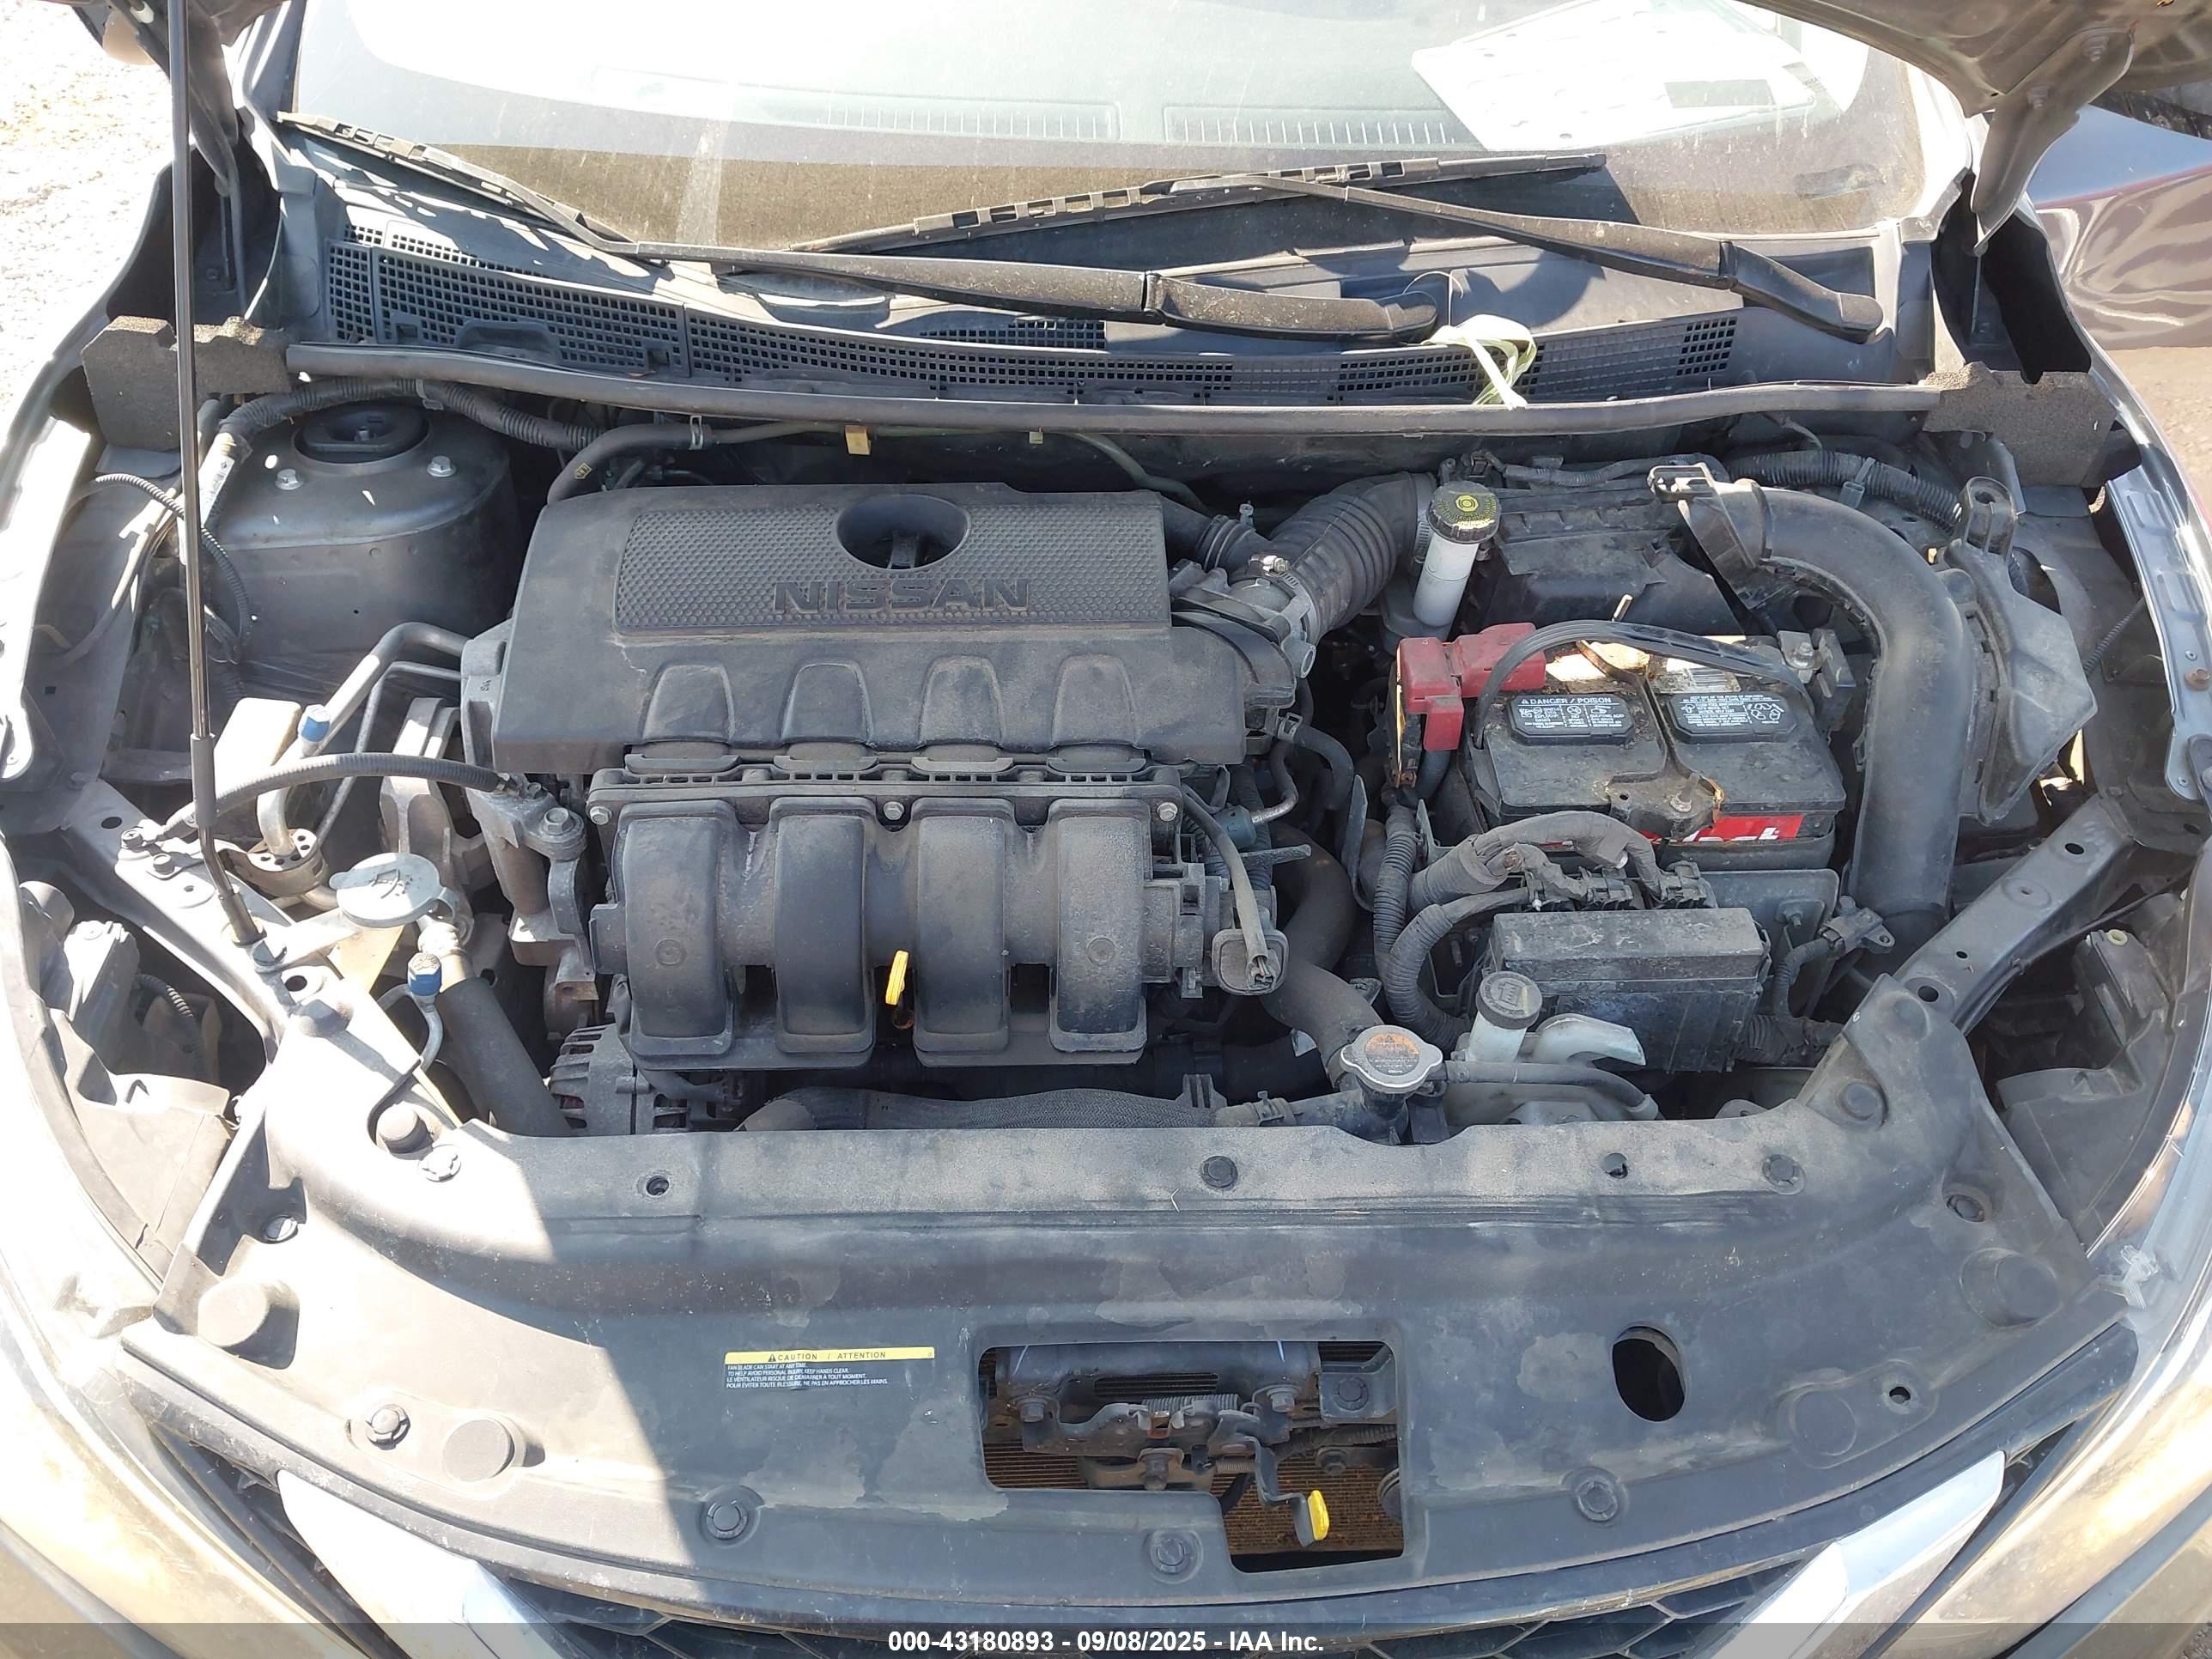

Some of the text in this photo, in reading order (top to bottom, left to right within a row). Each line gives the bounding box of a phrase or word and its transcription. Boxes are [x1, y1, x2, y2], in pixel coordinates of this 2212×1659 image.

[773, 578, 1030, 612] NISSAN
[777, 1352, 817, 1361] CAUTION
[837, 1351, 886, 1359] ATTENTION
